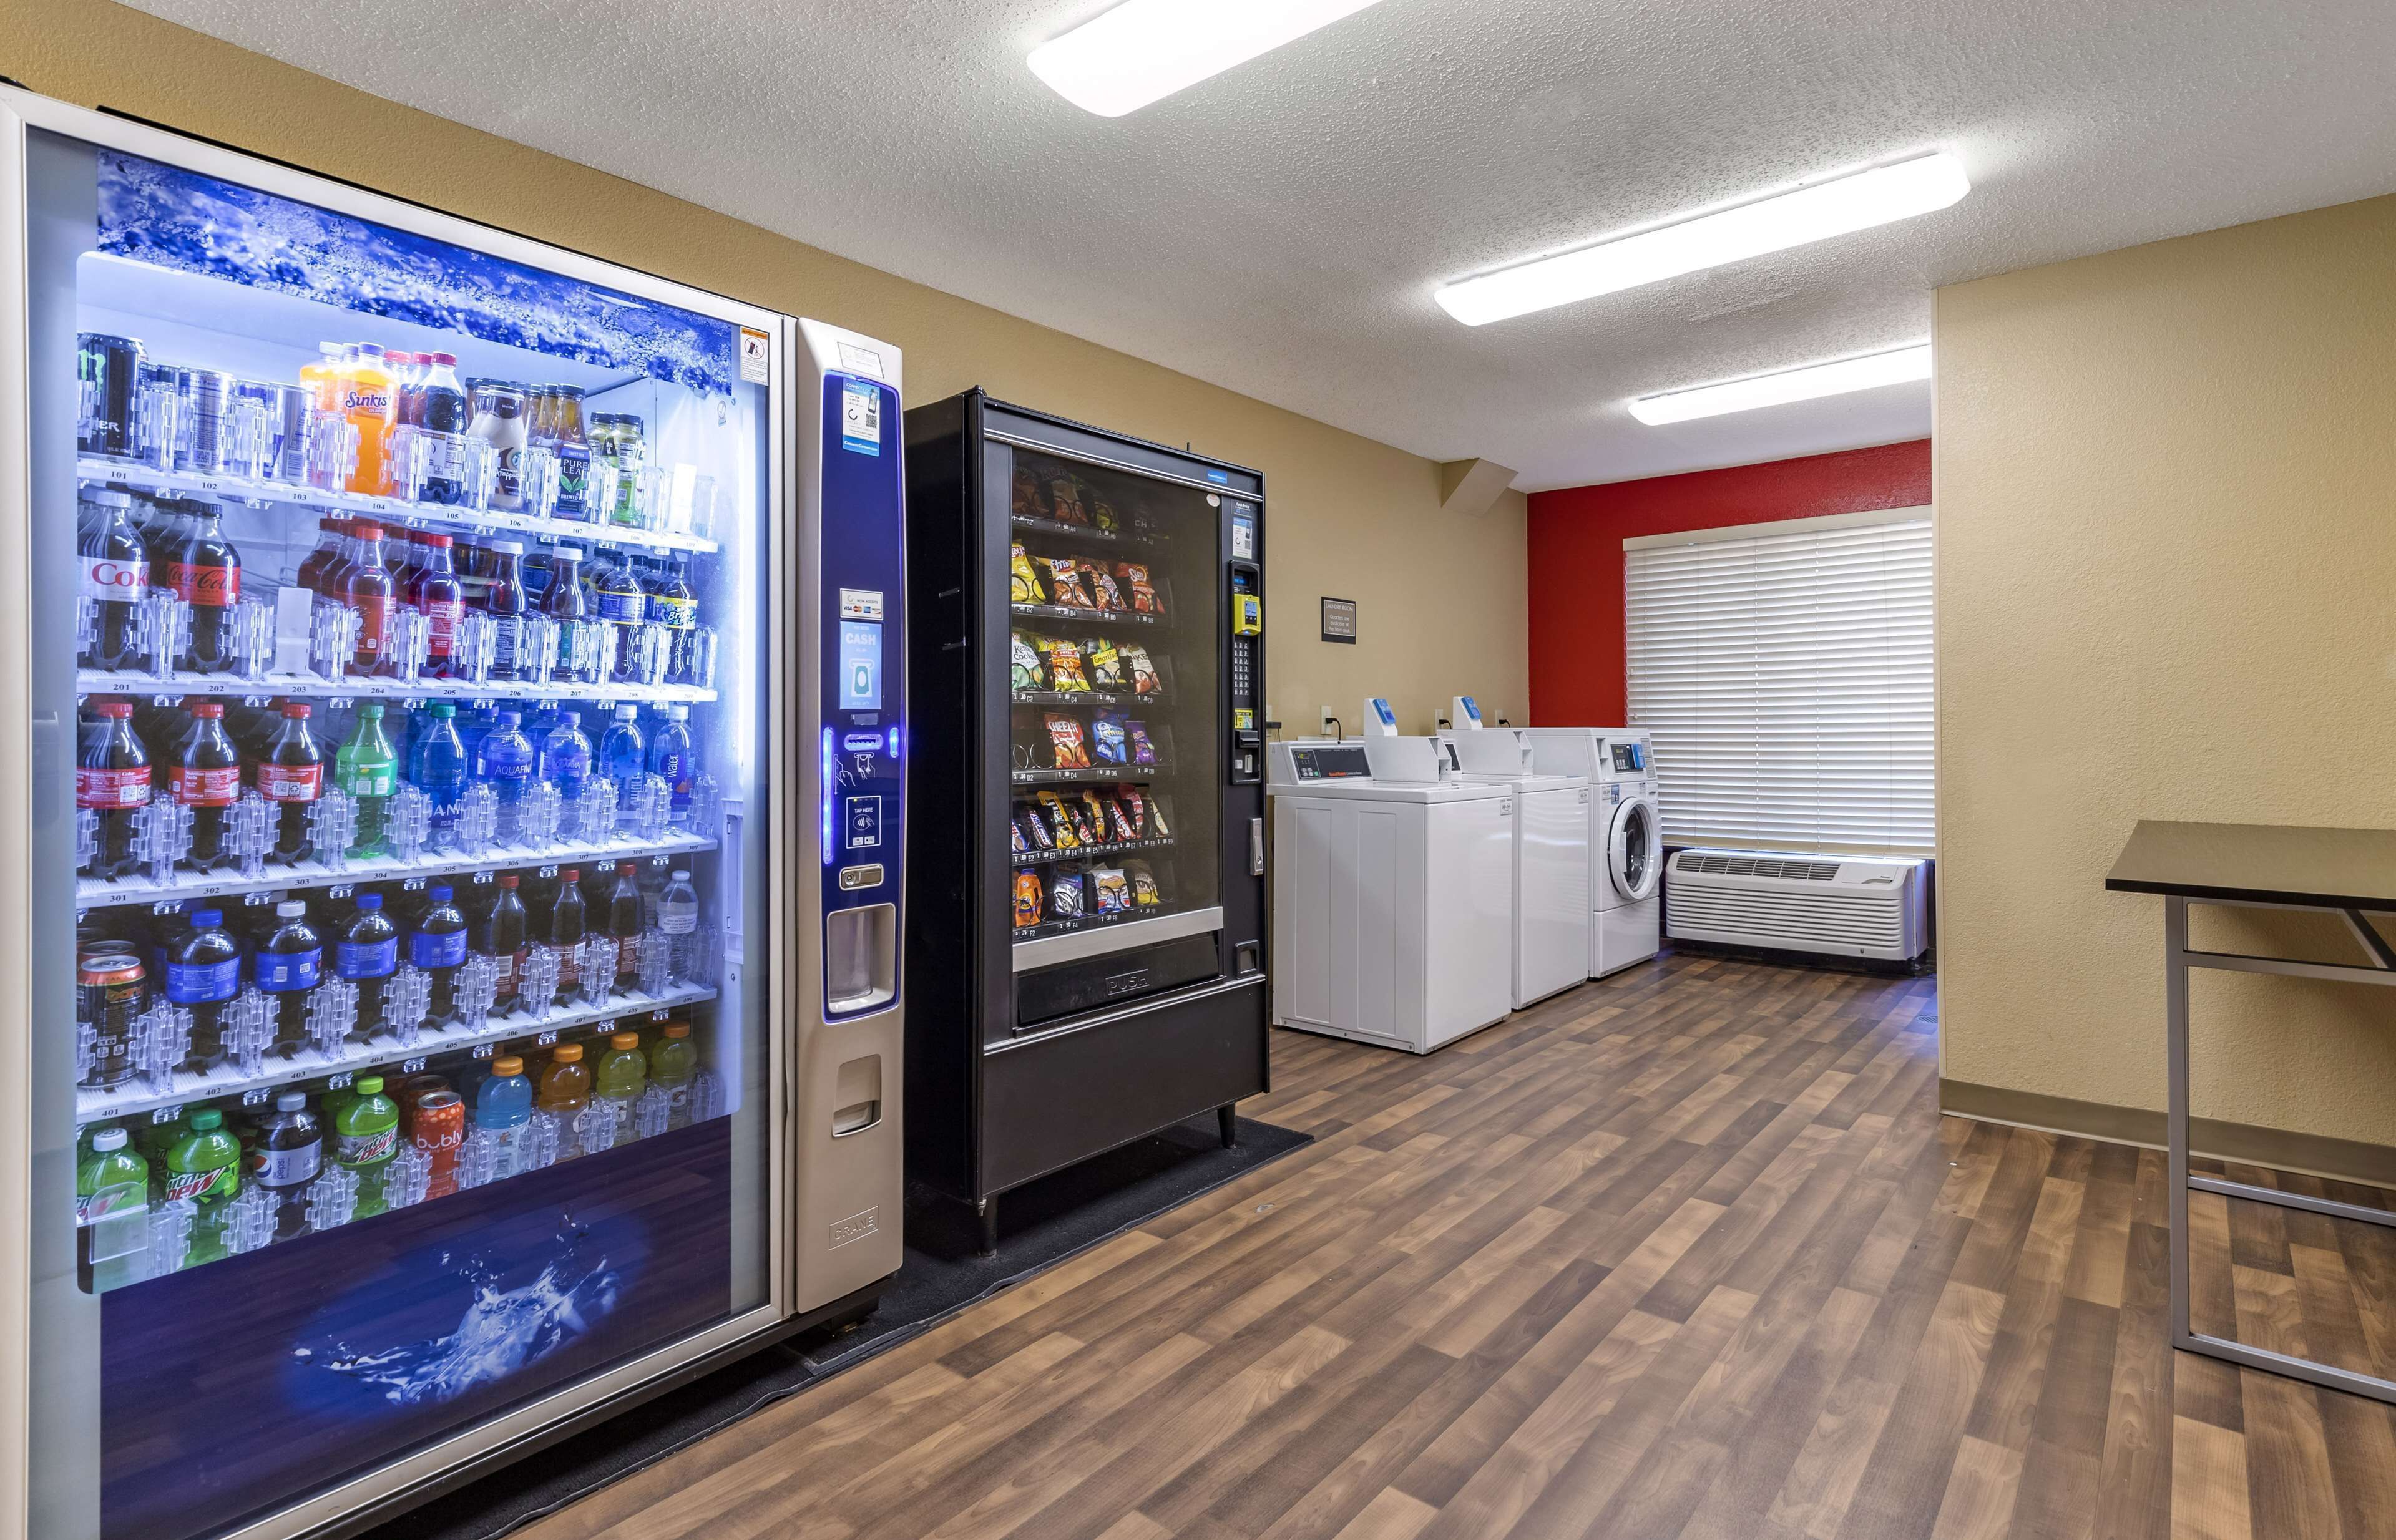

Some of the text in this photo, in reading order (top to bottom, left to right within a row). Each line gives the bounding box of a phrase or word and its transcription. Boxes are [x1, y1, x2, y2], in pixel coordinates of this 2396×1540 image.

[345, 391, 391, 408] Sunkis
[564, 459, 589, 469] PURE
[111, 471, 127, 479] 101
[845, 632, 876, 646] CASH
[1093, 653, 1118, 663] Smartfoo
[494, 764, 531, 776] AQUAFIN
[110, 894, 127, 902] 301
[1109, 975, 1149, 994] PUSH
[276, 1157, 285, 1179] pepsi
[834, 1216, 875, 1240] CRANE
